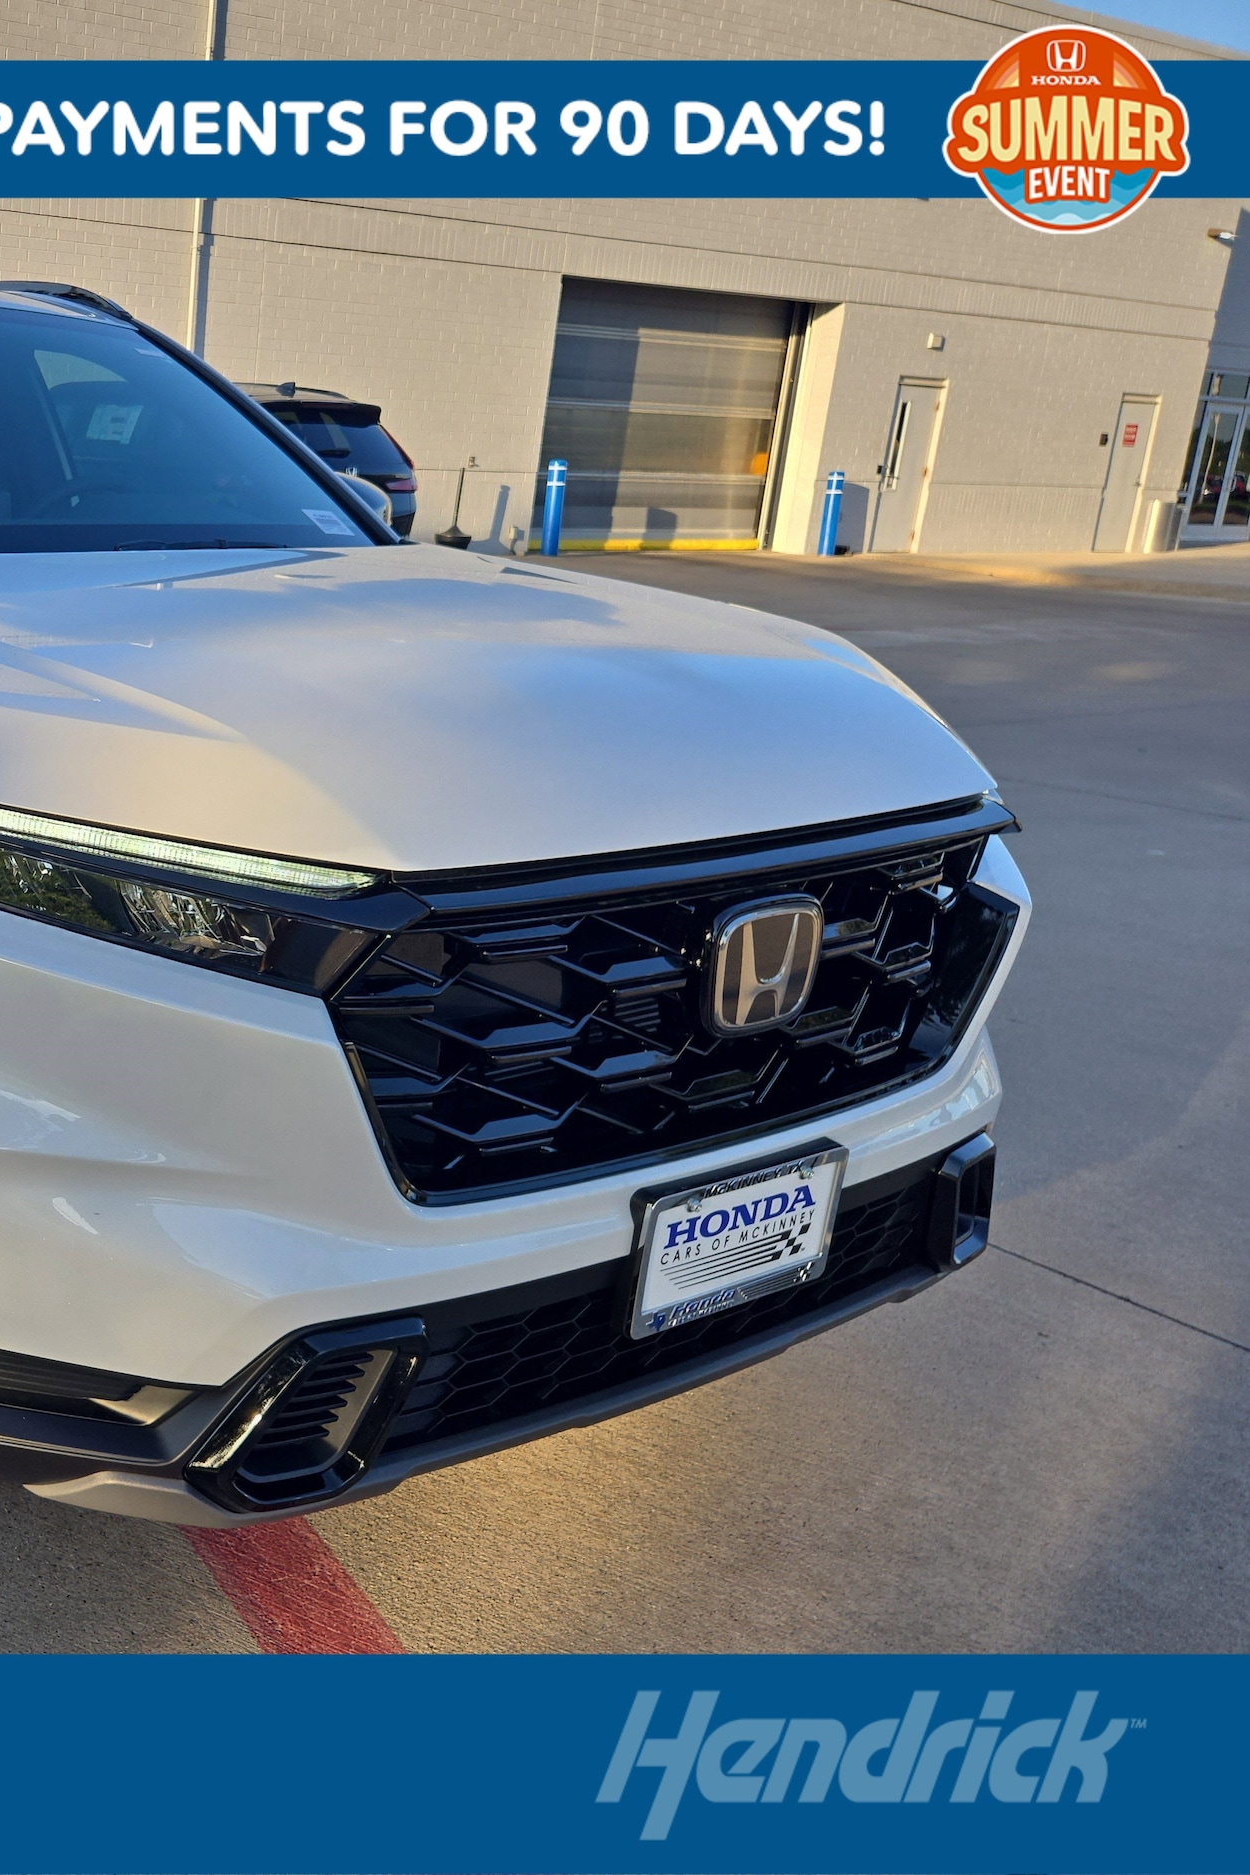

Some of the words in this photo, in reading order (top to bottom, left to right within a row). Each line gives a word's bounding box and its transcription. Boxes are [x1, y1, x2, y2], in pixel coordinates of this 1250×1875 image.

[660, 1245, 701, 1265] CARS
[711, 1235, 730, 1251] OF
[738, 1208, 816, 1244] MCKINNEY
[663, 1184, 817, 1250] HONDA
